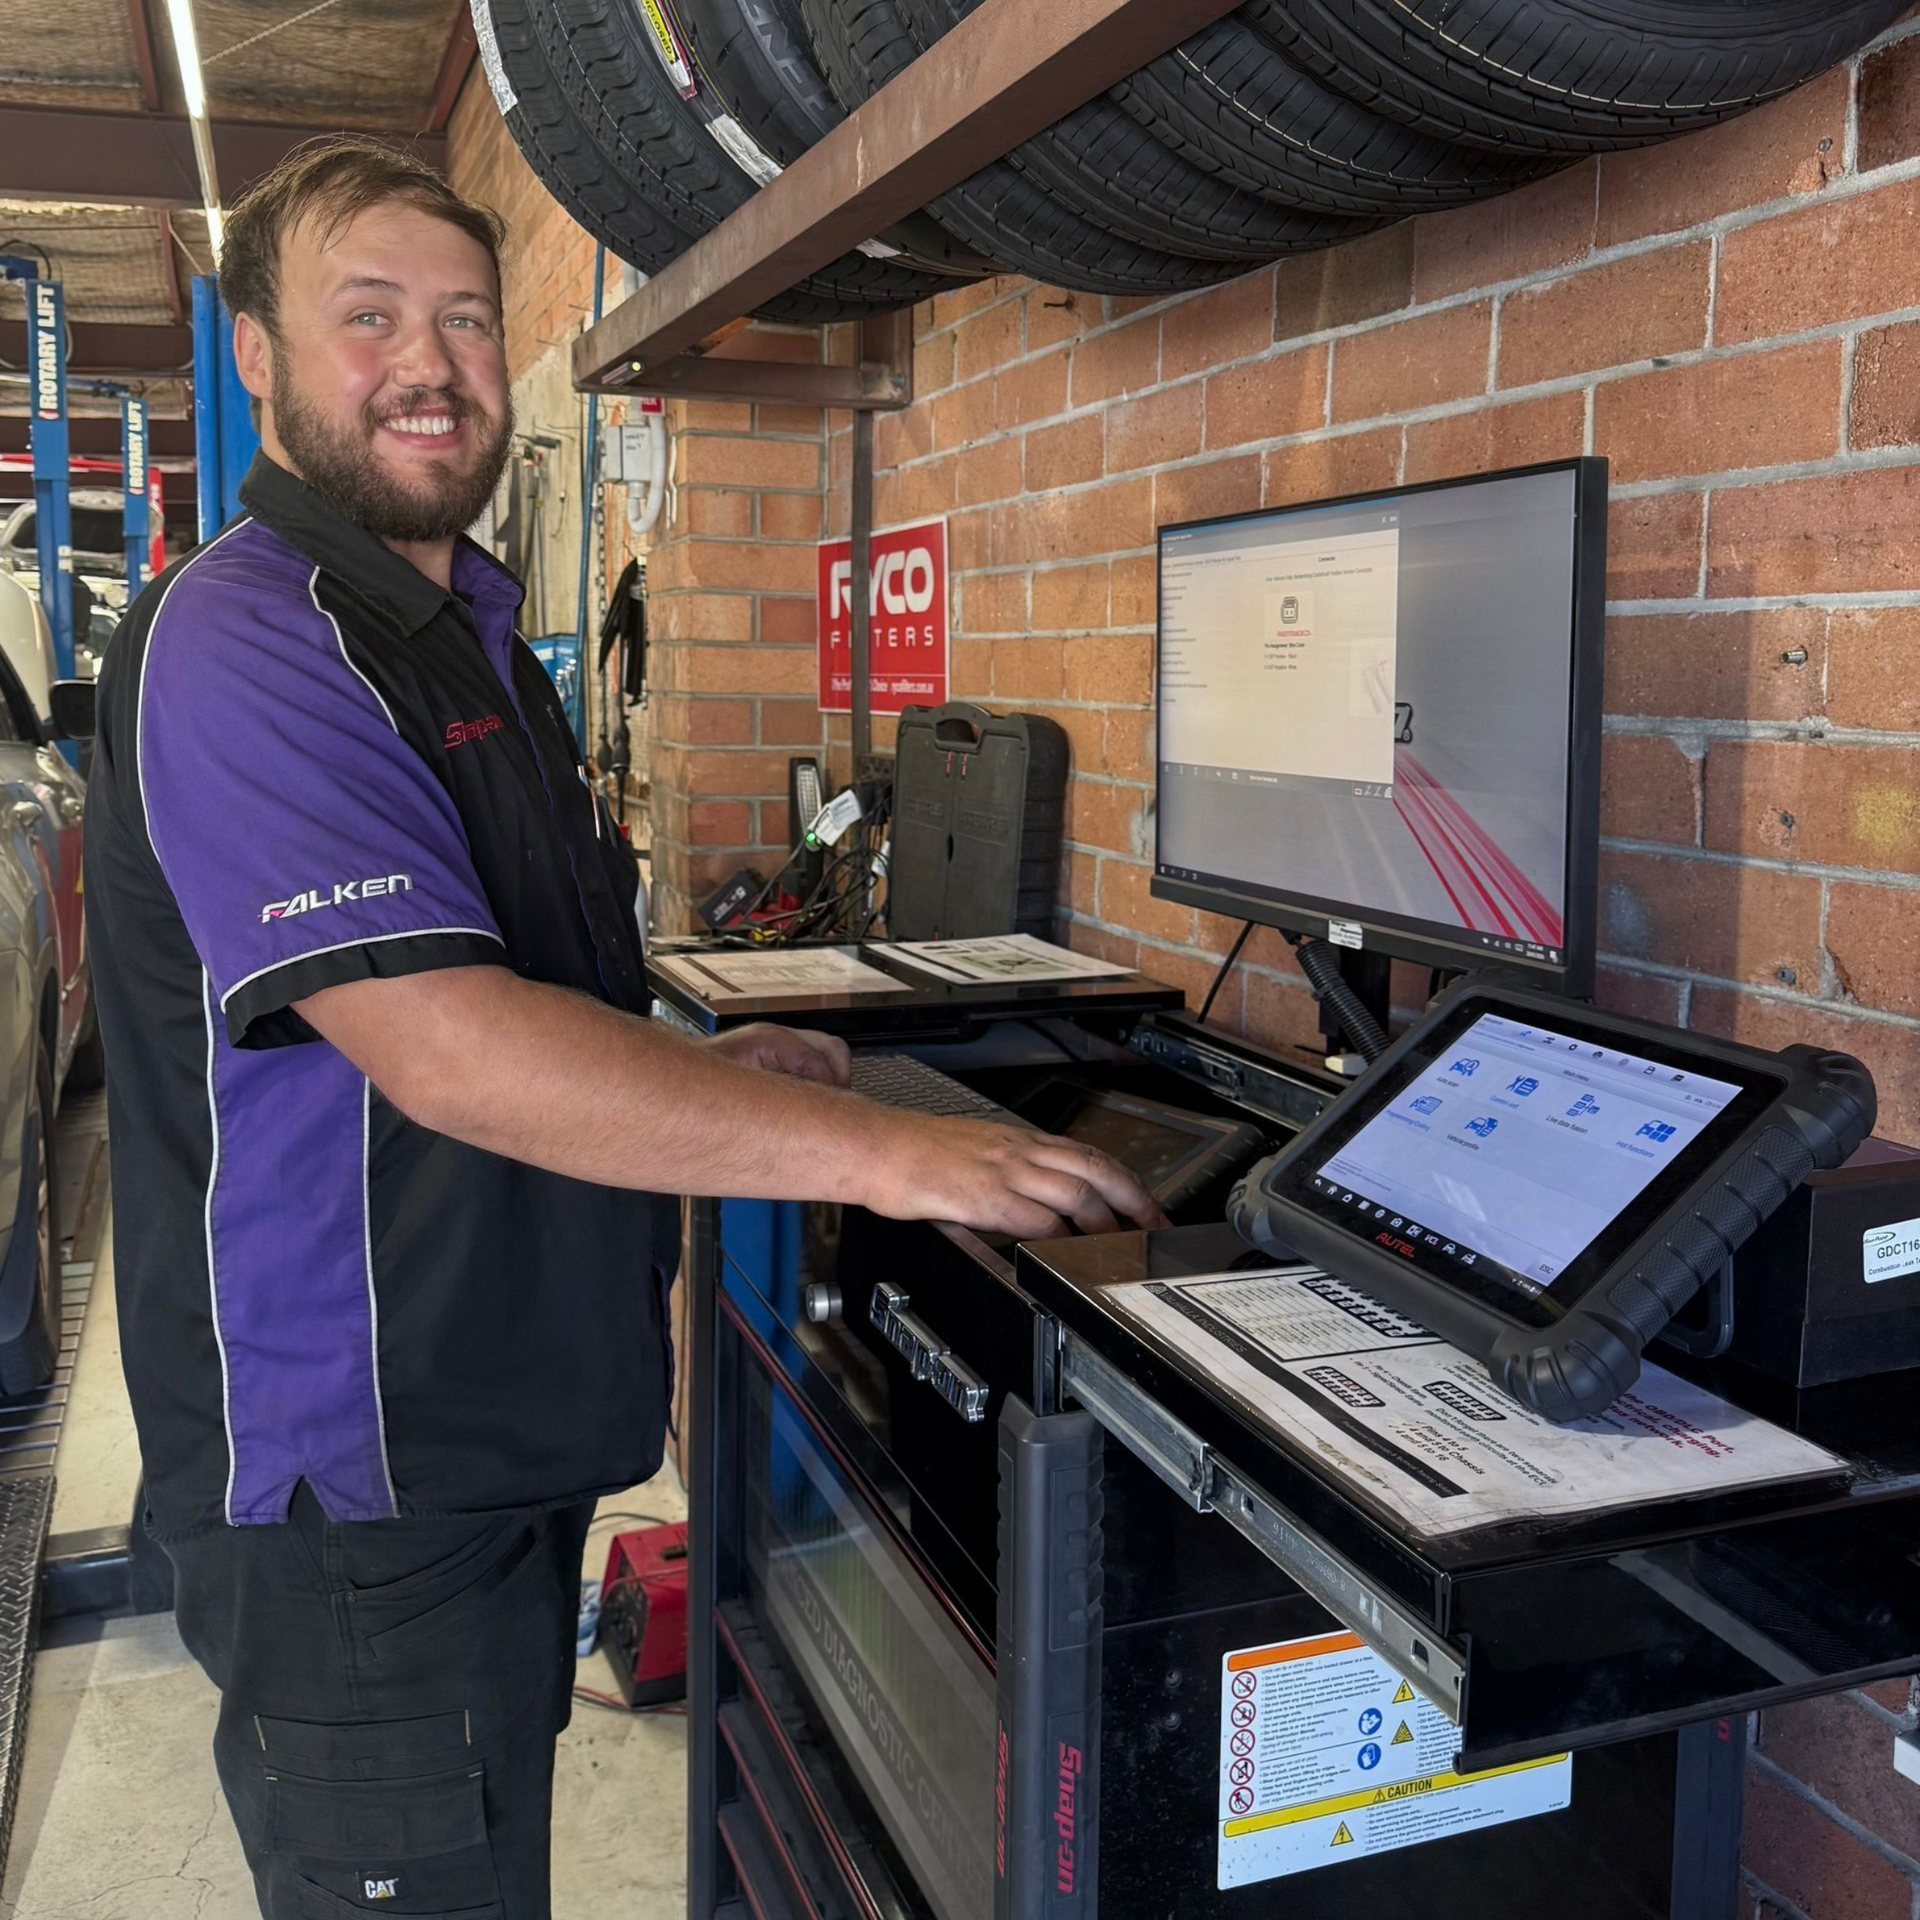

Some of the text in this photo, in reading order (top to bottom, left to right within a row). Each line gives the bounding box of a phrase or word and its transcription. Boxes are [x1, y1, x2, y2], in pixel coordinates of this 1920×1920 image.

[37, 284, 58, 409] ROTARY LIFT
[128, 400, 144, 488] ROTARY LIFT
[258, 873, 414, 924] FALKEN
[1446, 1080, 1460, 1088] scan
[1545, 1115, 1589, 1135] Live data fusion
[1445, 1133, 1481, 1151] Vehicle profile
[1614, 1139, 1656, 1159] Hot functions
[1376, 1232, 1416, 1258] AUTEL
[1539, 1263, 1554, 1275] ESC
[1868, 1263, 1901, 1275] Combustion
[1199, 1316, 1248, 1353] INDUSTRIES
[1422, 1426, 1443, 1436] Pins
[1624, 1392, 1644, 1404] the
[1645, 1405, 1704, 1434] OBD/DLC
[1701, 1434, 1735, 1453] Port.
[1629, 1416, 1684, 1449] network.
[1401, 1434, 1419, 1444] and
[1662, 1423, 1721, 1458] charging,
[1415, 1432, 1432, 1441] and
[1448, 1452, 1485, 1473] Chassis
[1508, 1452, 1524, 1460] two
[1513, 1465, 1530, 1473] the
[1387, 1779, 1433, 1798] CAUTION
[1054, 1741, 1082, 1893] Snap-on
[364, 1877, 399, 1899] CAT
